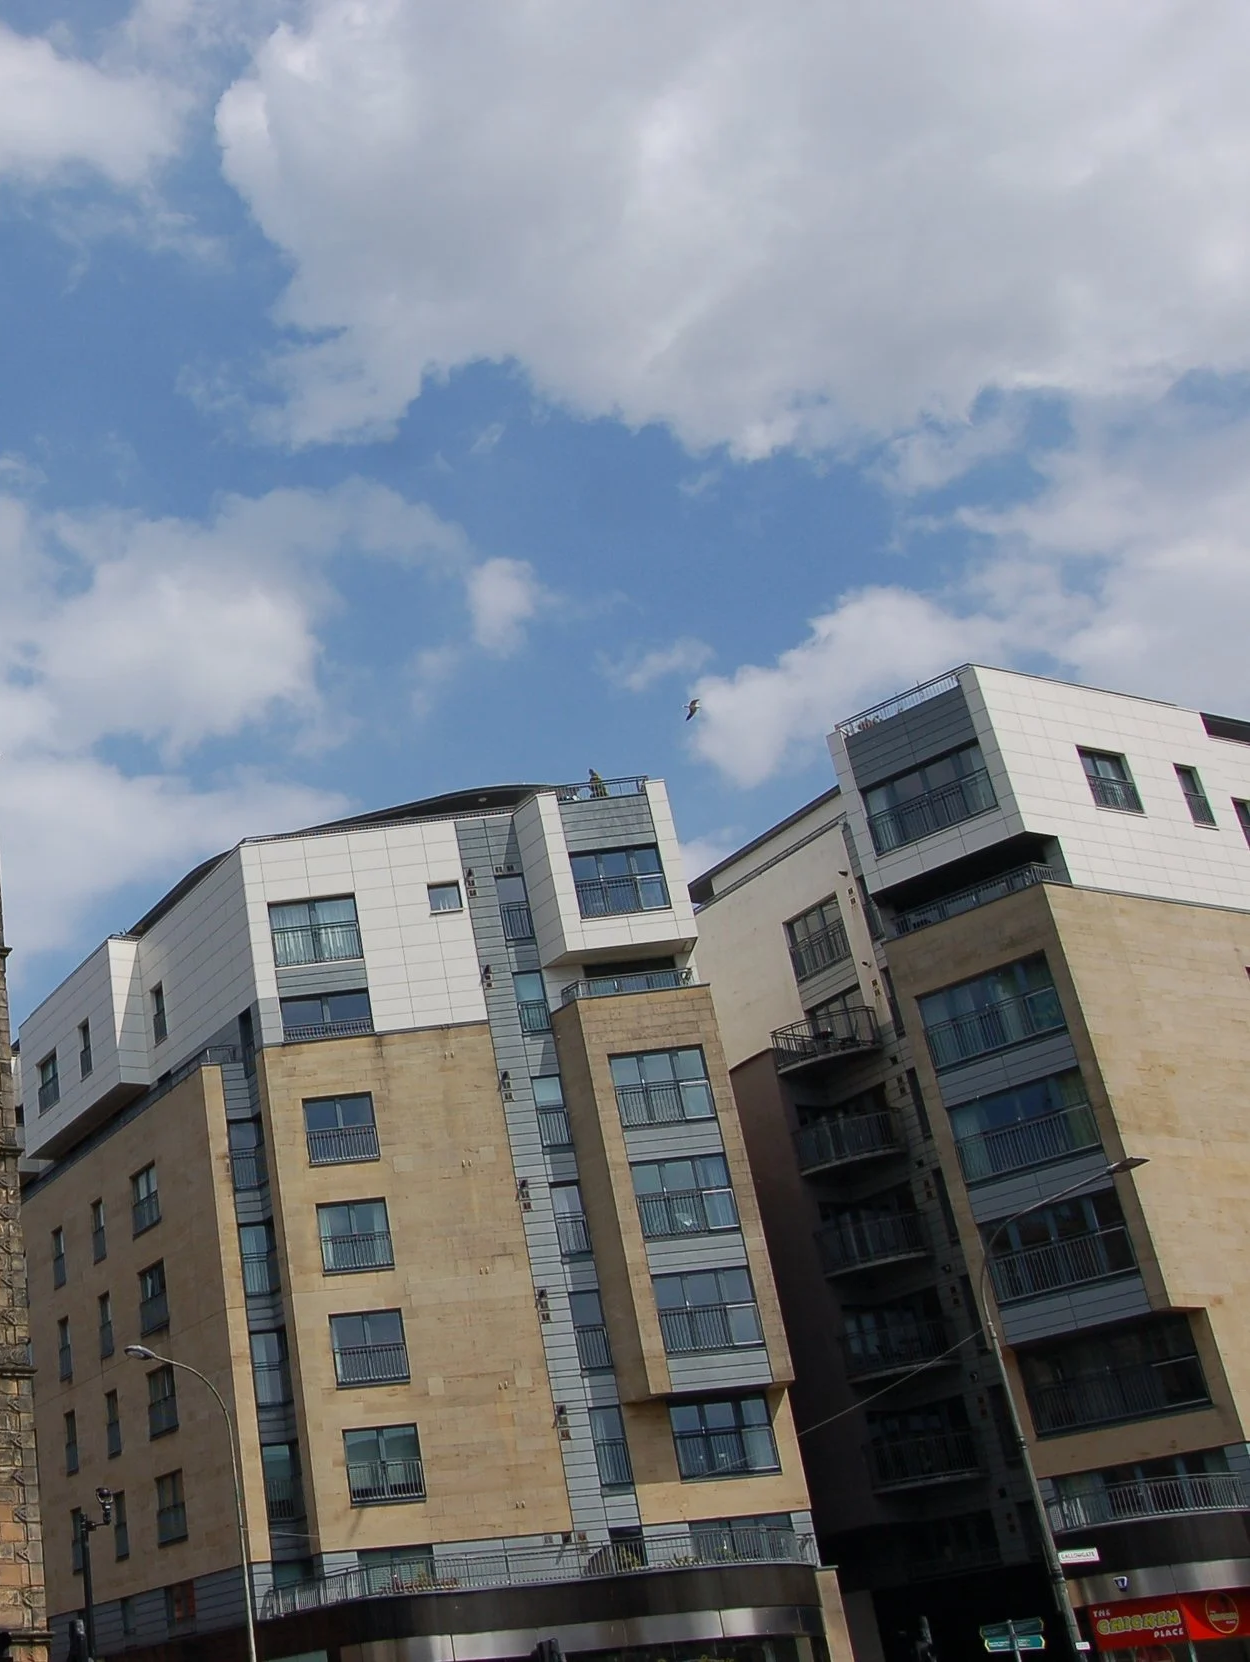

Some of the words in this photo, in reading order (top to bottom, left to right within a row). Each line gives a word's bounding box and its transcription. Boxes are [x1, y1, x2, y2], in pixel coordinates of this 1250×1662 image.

[1092, 1608, 1111, 1618] THE
[1096, 1609, 1182, 1636] CHICKEN
[1153, 1627, 1184, 1638] PLACE
